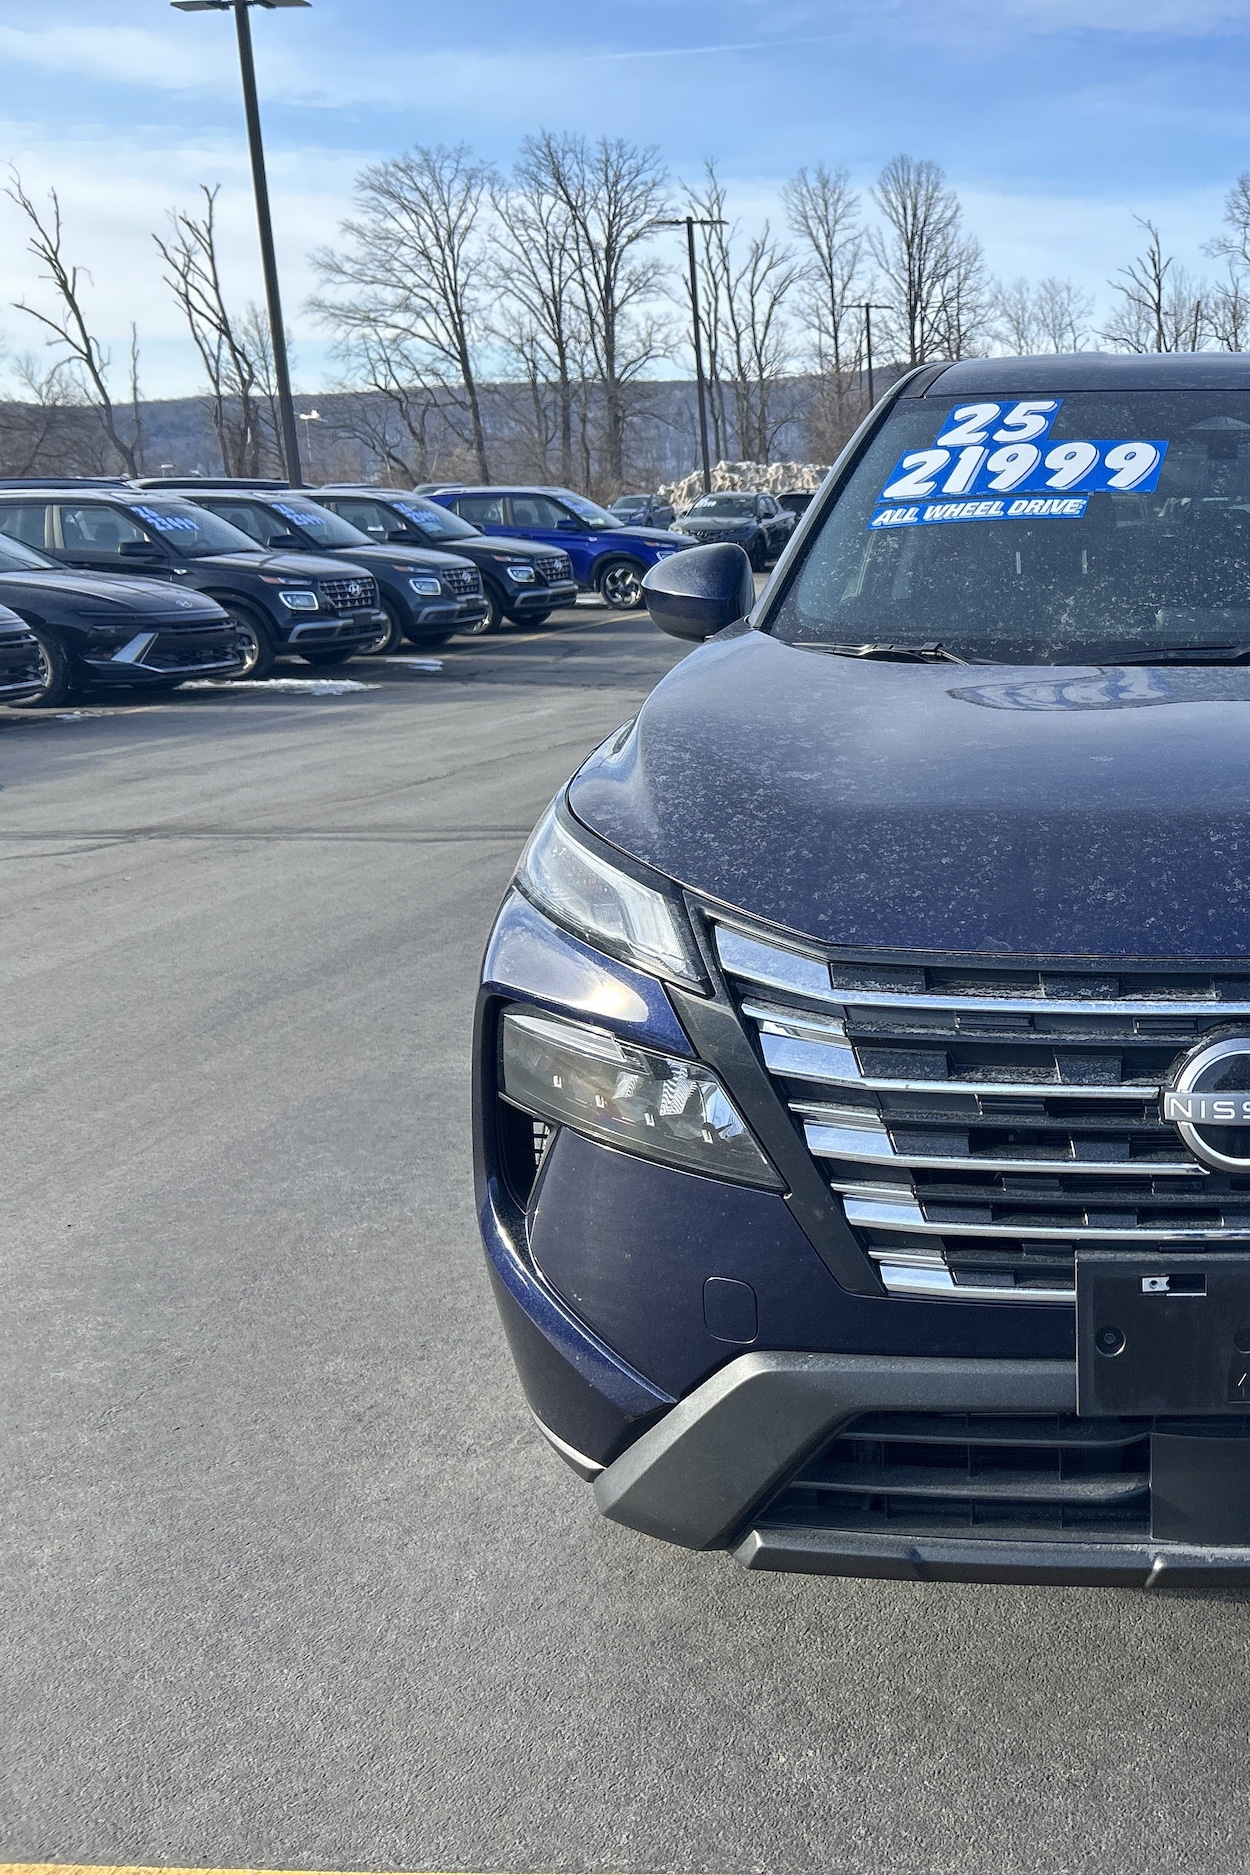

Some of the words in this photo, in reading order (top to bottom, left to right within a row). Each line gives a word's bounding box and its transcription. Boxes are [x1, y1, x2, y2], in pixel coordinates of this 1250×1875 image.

[937, 401, 1058, 446] 25
[883, 442, 1160, 499] 21999
[871, 508, 919, 526] ALL
[923, 501, 1004, 520] WHEEL
[1008, 497, 1087, 515] DRIVE
